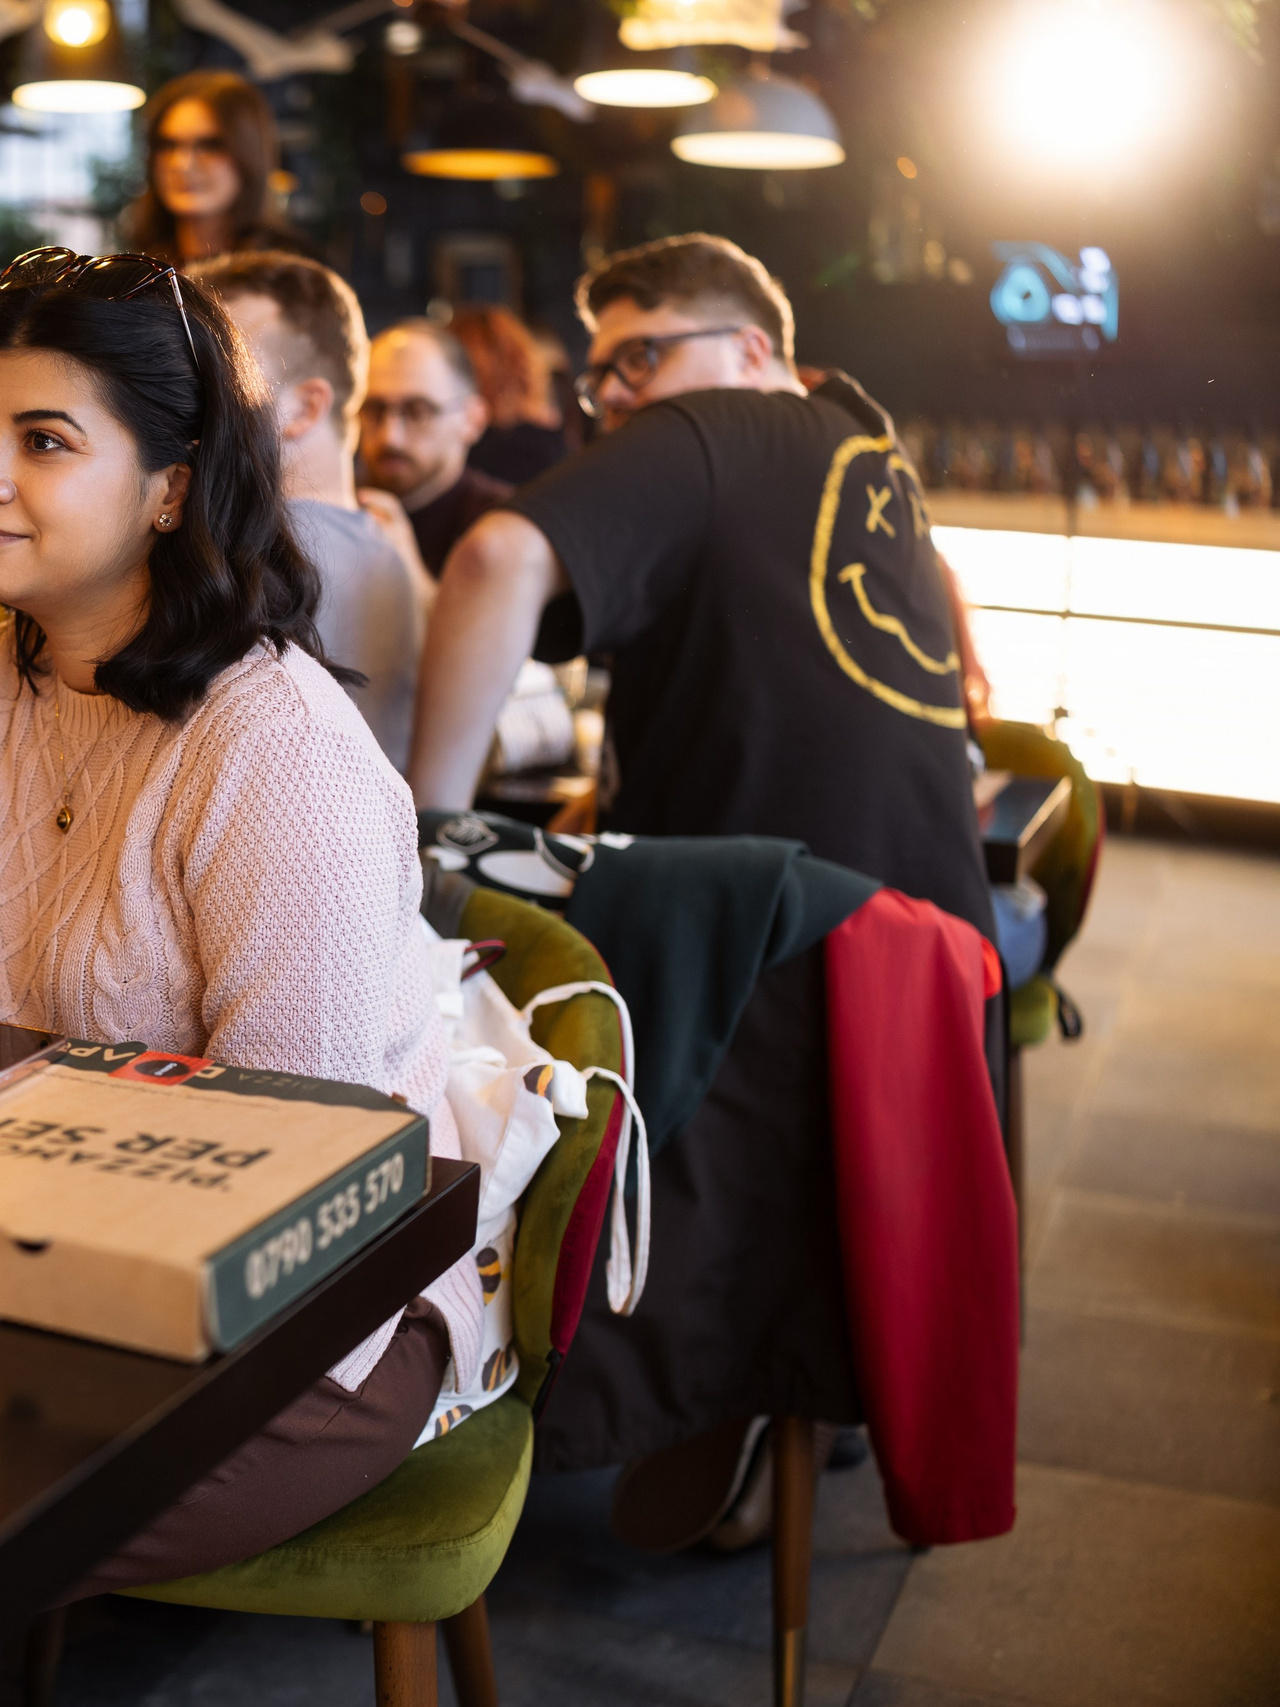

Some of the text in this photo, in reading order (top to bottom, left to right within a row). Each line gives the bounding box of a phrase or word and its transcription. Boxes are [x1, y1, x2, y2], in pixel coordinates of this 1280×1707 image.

[238, 1071, 320, 1092] PIZZA
[114, 1131, 273, 1169] PER
[244, 1216, 313, 1299] 0790
[364, 1151, 405, 1215] 570
